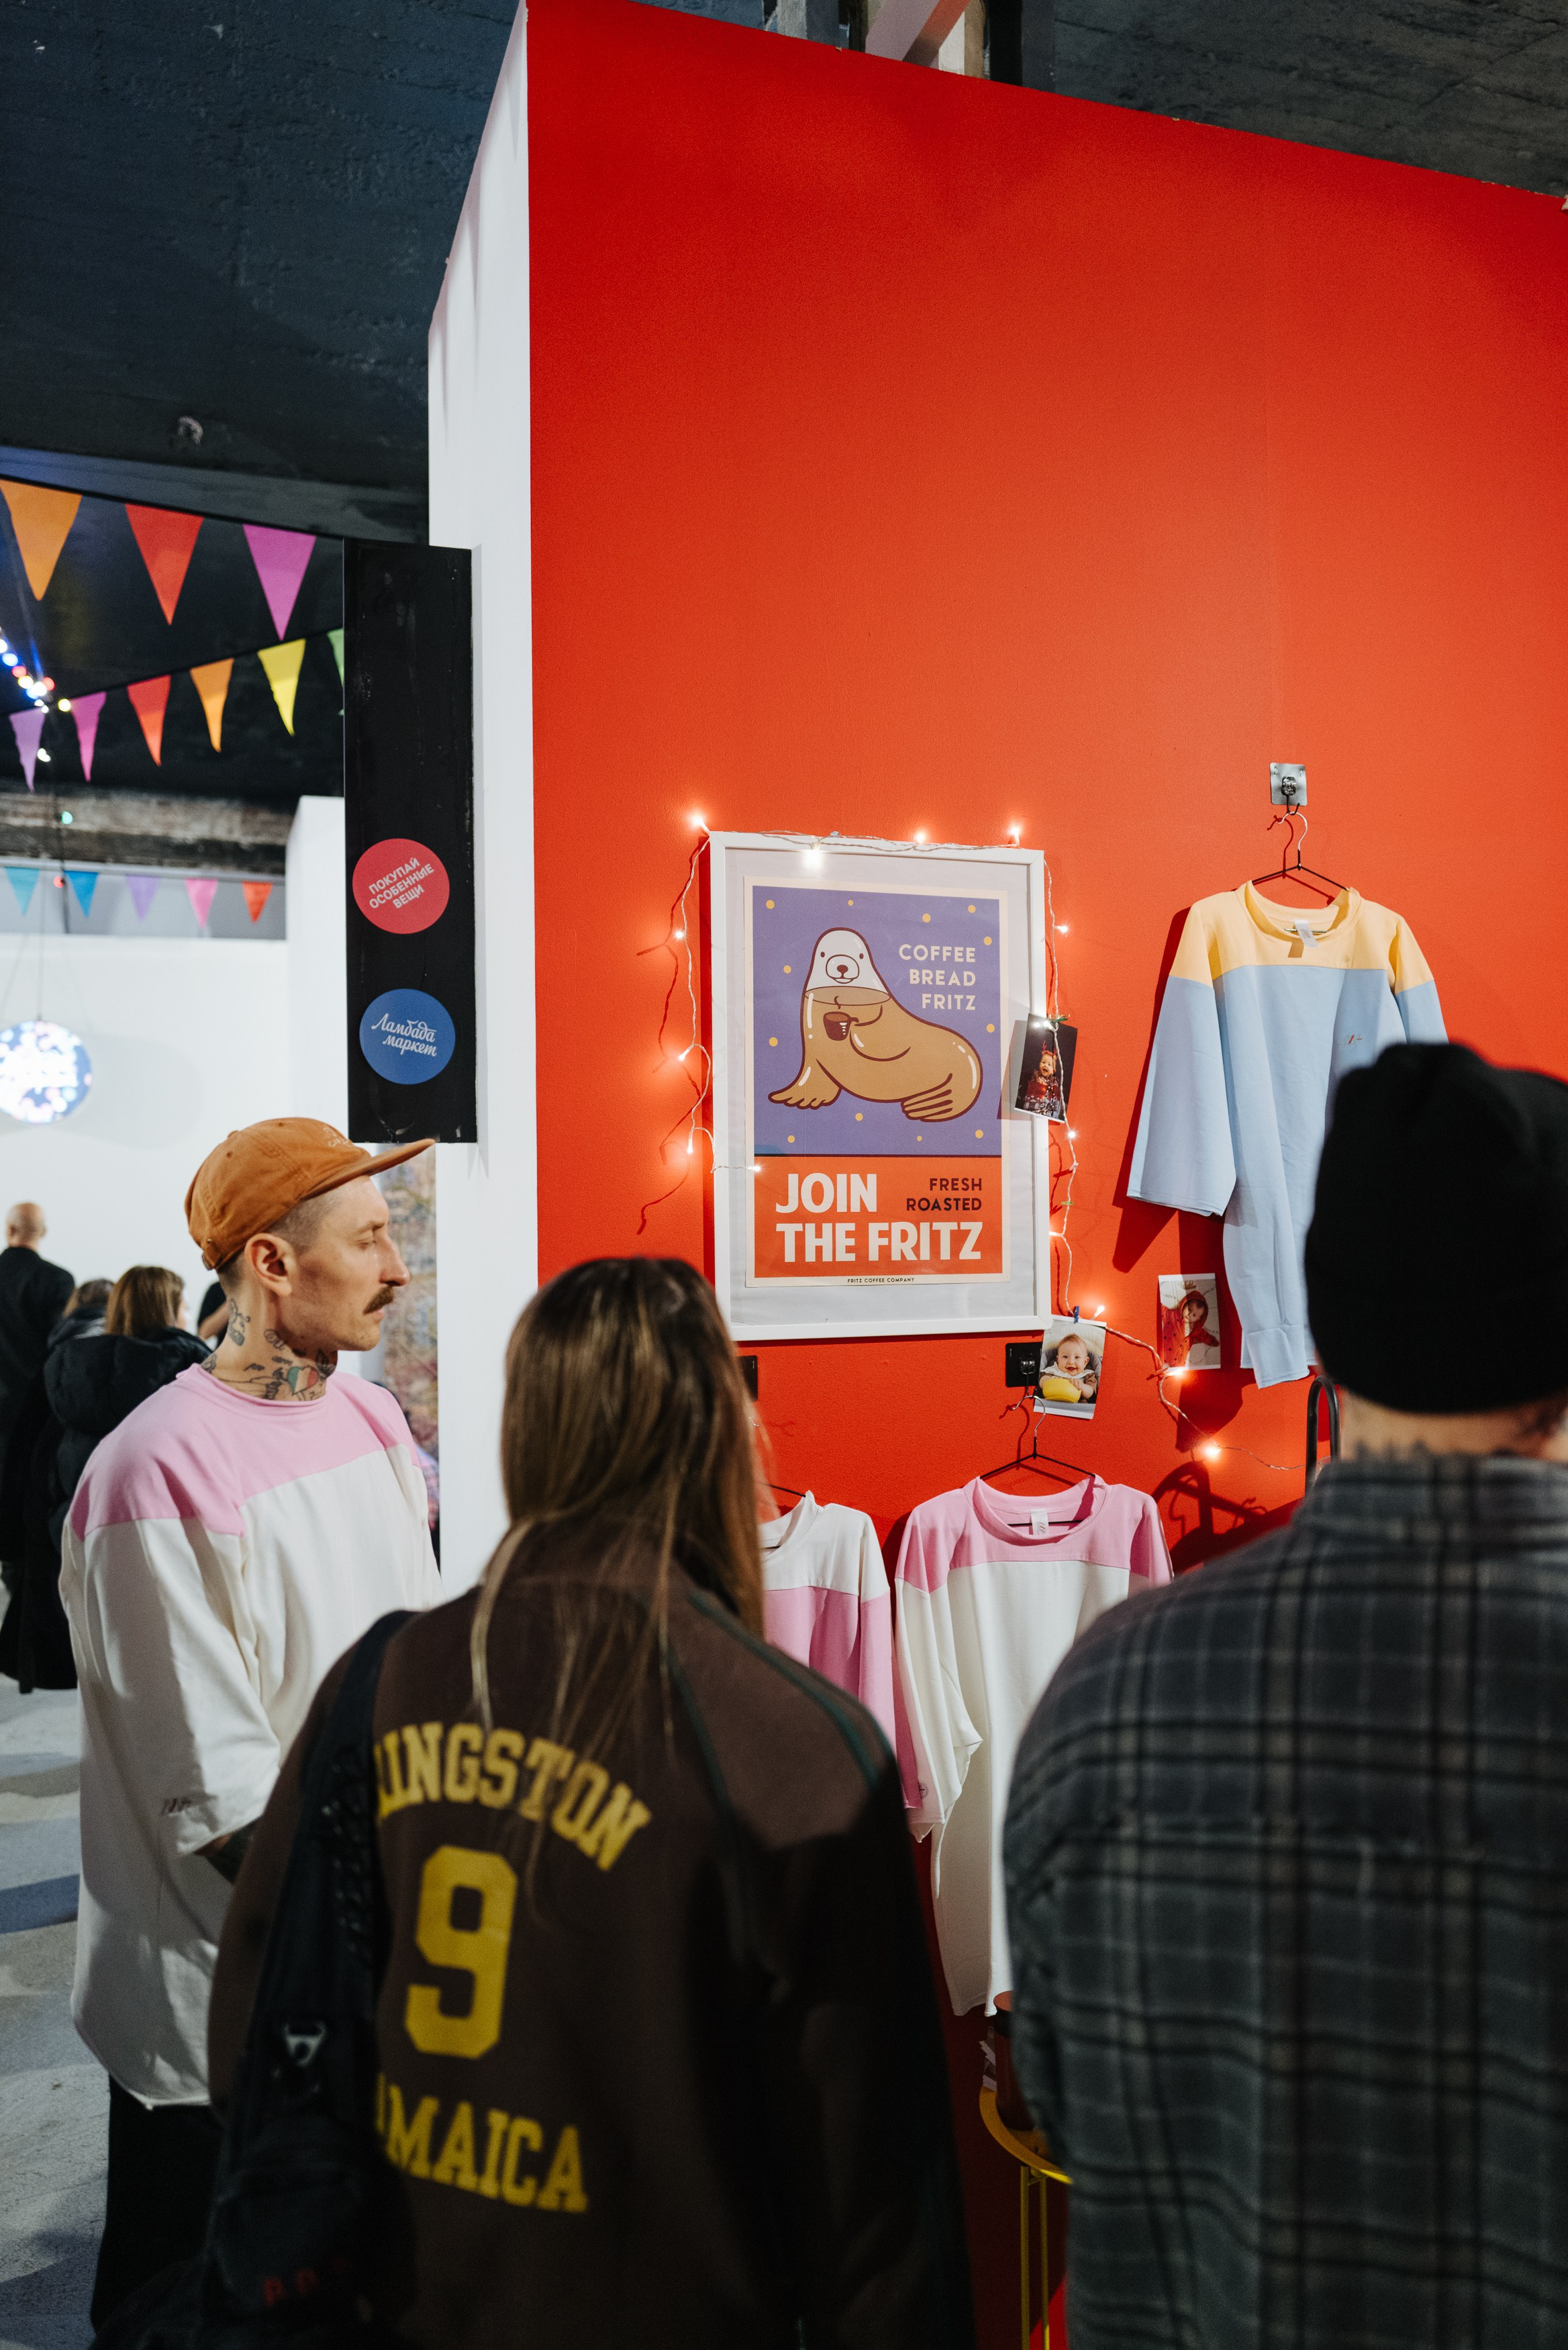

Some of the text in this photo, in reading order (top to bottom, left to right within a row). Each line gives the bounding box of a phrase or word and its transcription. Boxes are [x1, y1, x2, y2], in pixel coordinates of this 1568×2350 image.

[369, 857, 420, 894] ПОКУПАЙ
[369, 863, 434, 908] ОСОБЕННЫЕ
[392, 884, 425, 908] ВЕЩИ
[899, 943, 976, 962] COFFEE
[910, 968, 976, 986] BREAD
[922, 993, 976, 1010] FRITZ
[371, 1013, 437, 1043] Ламбада
[382, 1035, 437, 1057] маркет
[775, 1172, 877, 1213] JOIN
[929, 1177, 982, 1192] FRESH
[906, 1197, 982, 1211] ROASTED
[775, 1221, 983, 1262] THE FRITZ
[405, 1844, 518, 2059] 9
[376, 2073, 589, 2213] MAICA
